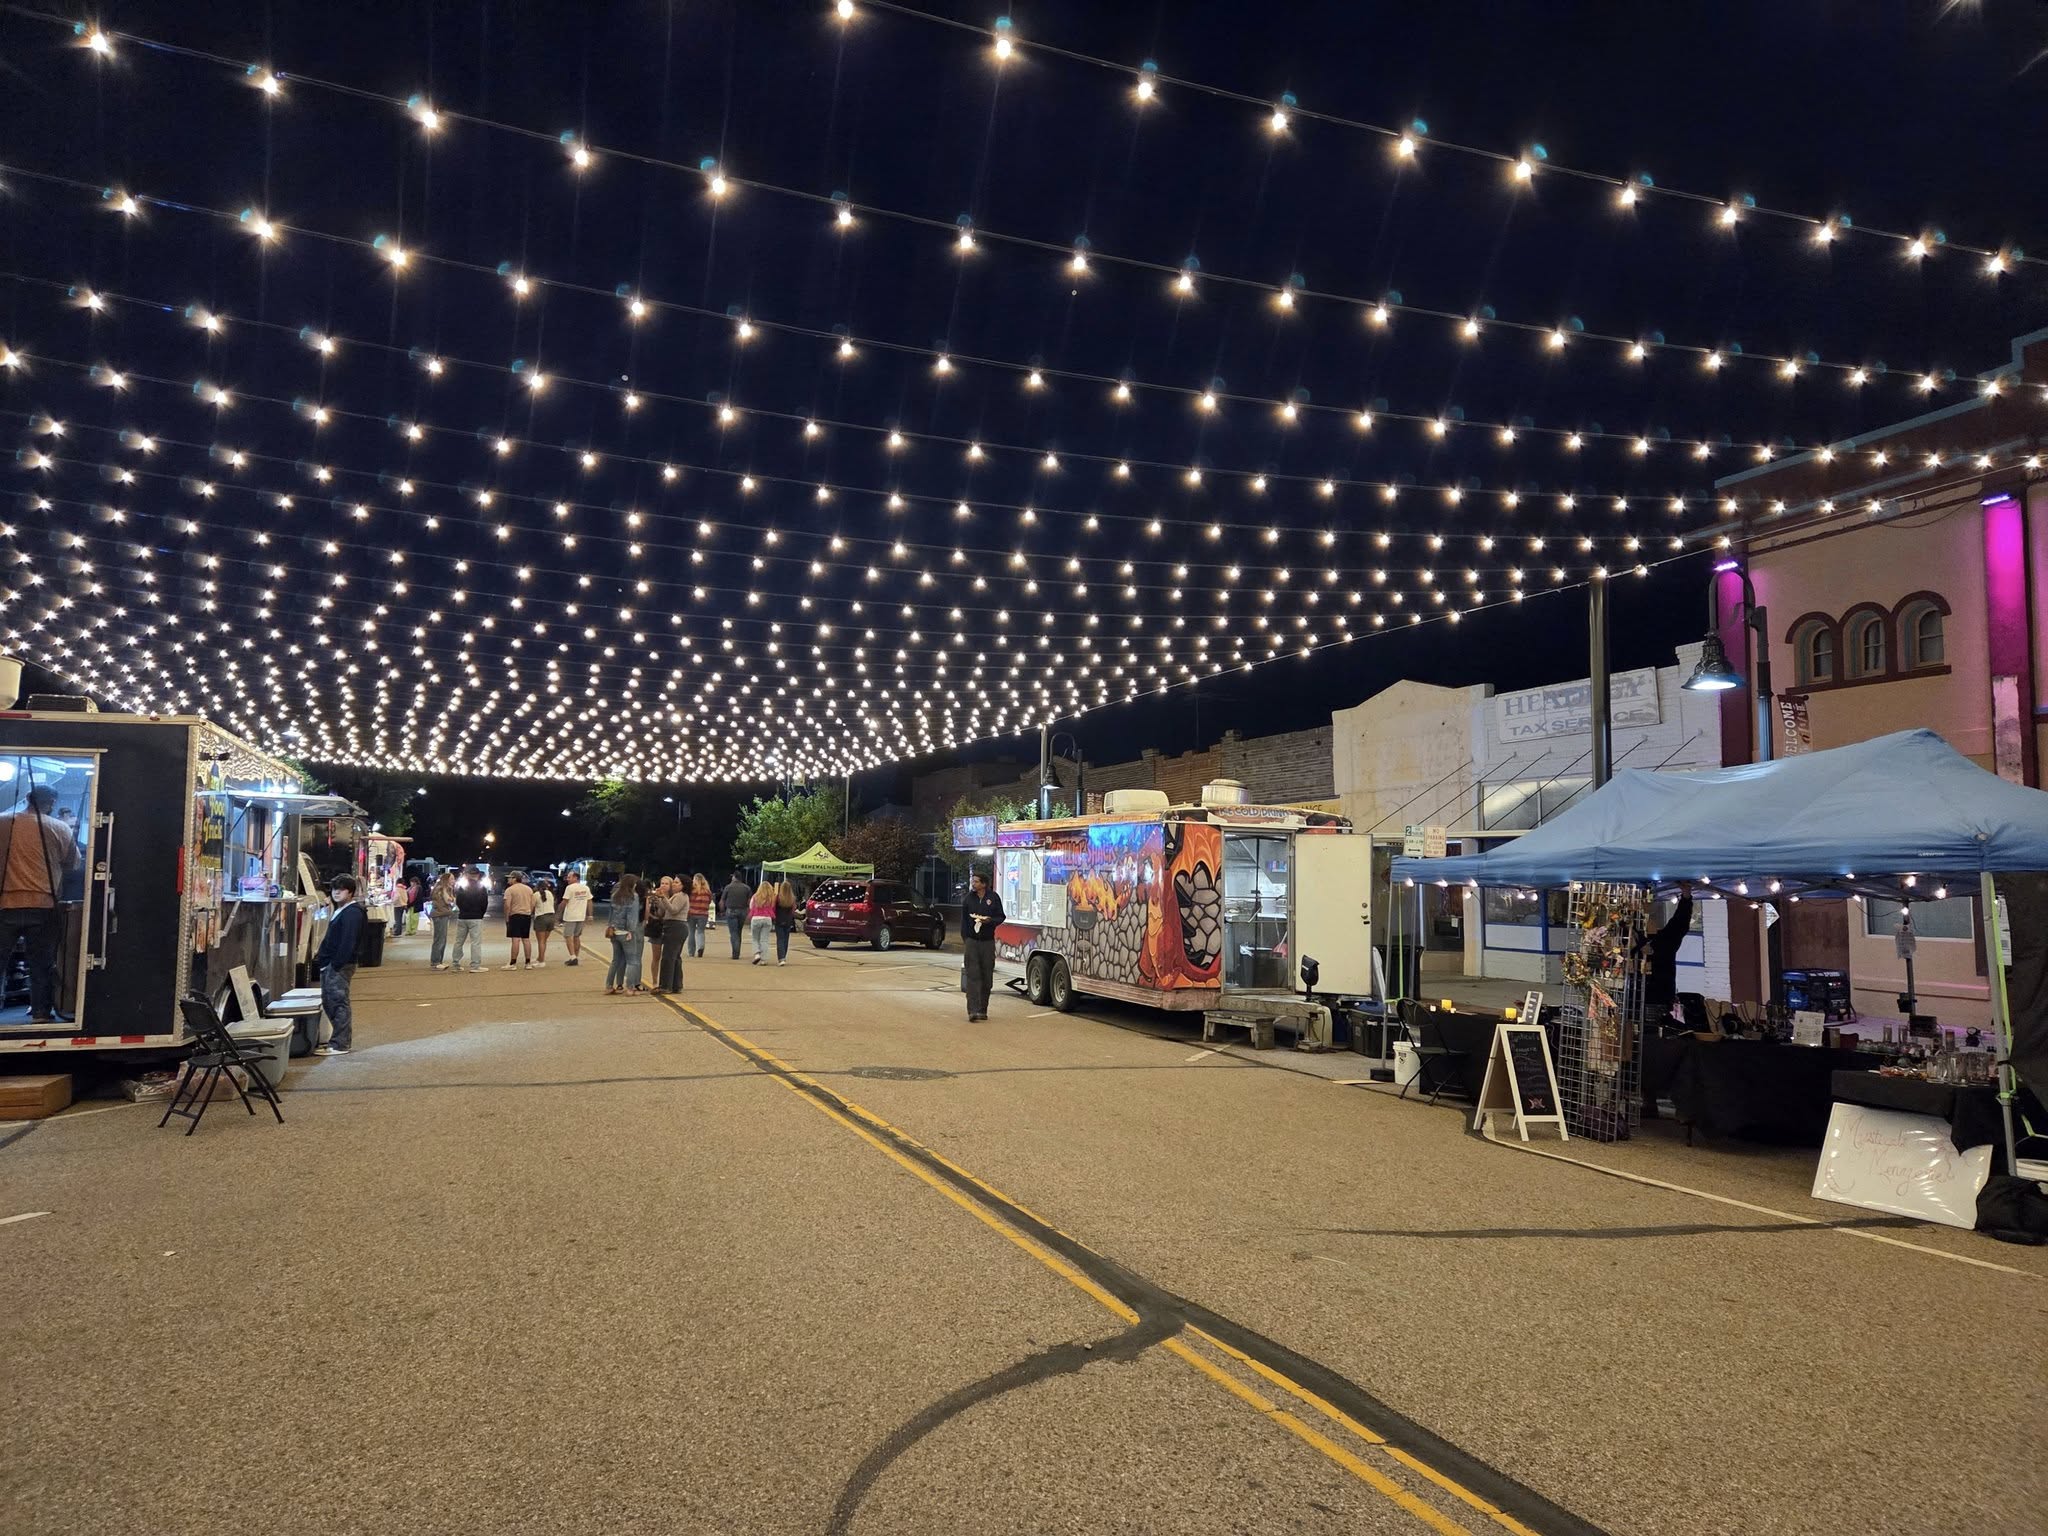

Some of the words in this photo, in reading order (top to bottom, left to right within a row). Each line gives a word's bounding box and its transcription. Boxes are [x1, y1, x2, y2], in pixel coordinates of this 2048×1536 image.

[1509, 722, 1548, 736] TAX
[1551, 708, 1645, 732] SERCE
[1234, 806, 1260, 817] COLD
